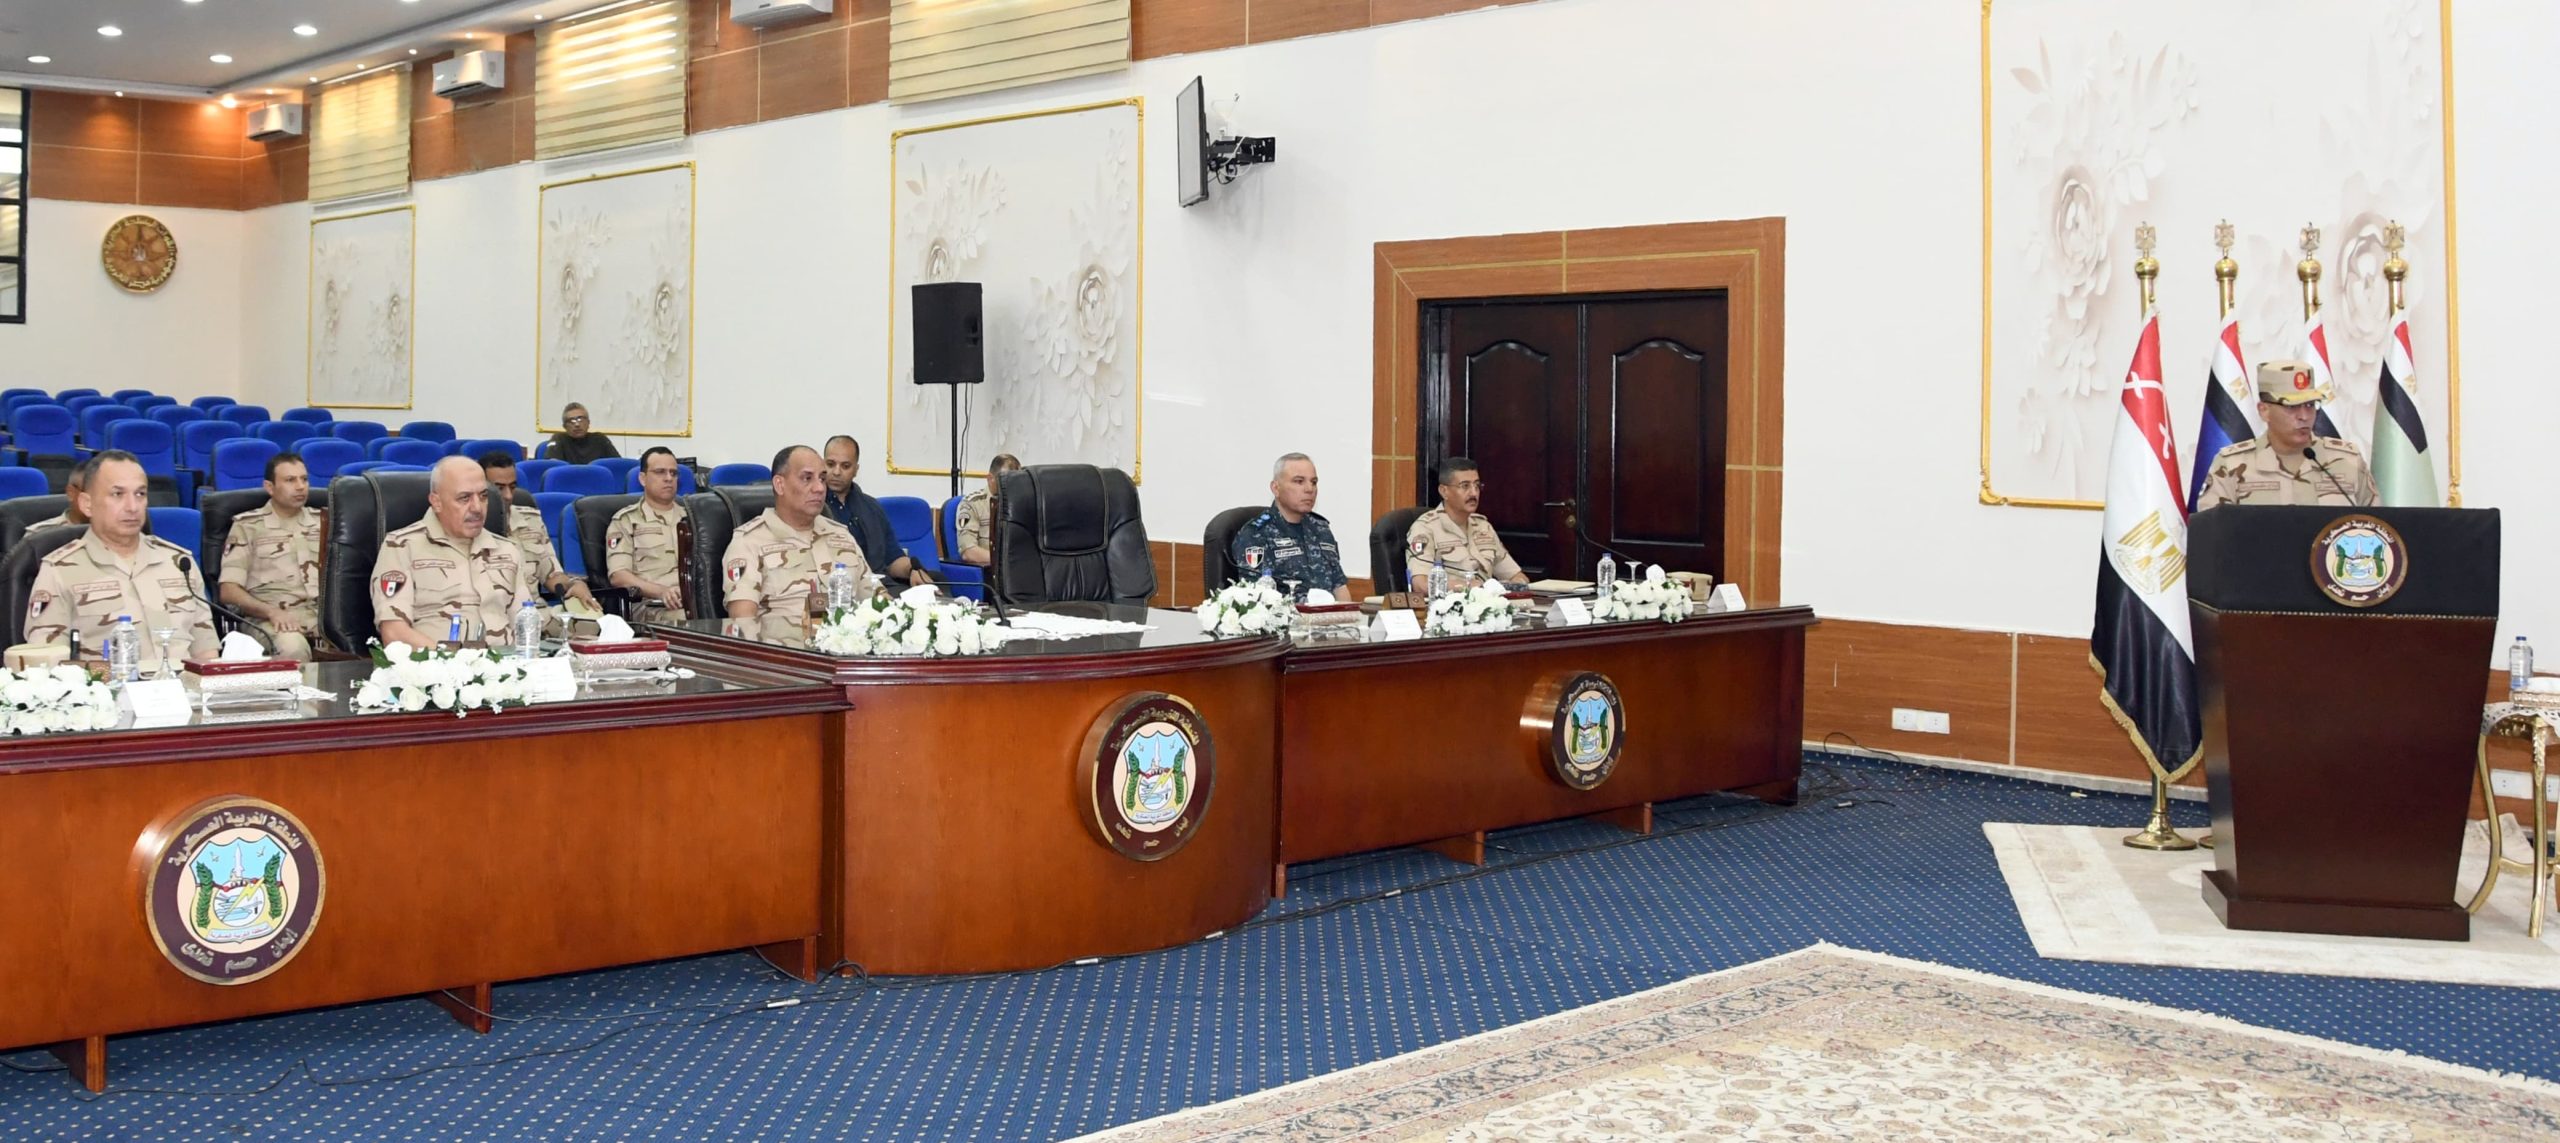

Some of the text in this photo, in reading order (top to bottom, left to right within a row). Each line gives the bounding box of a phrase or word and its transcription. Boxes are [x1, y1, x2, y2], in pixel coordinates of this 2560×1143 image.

[2351, 520, 2376, 529] الغربية
[168, 811, 303, 867] المنطقة الغربية العسكرية
[225, 956, 258, 974] حسم
